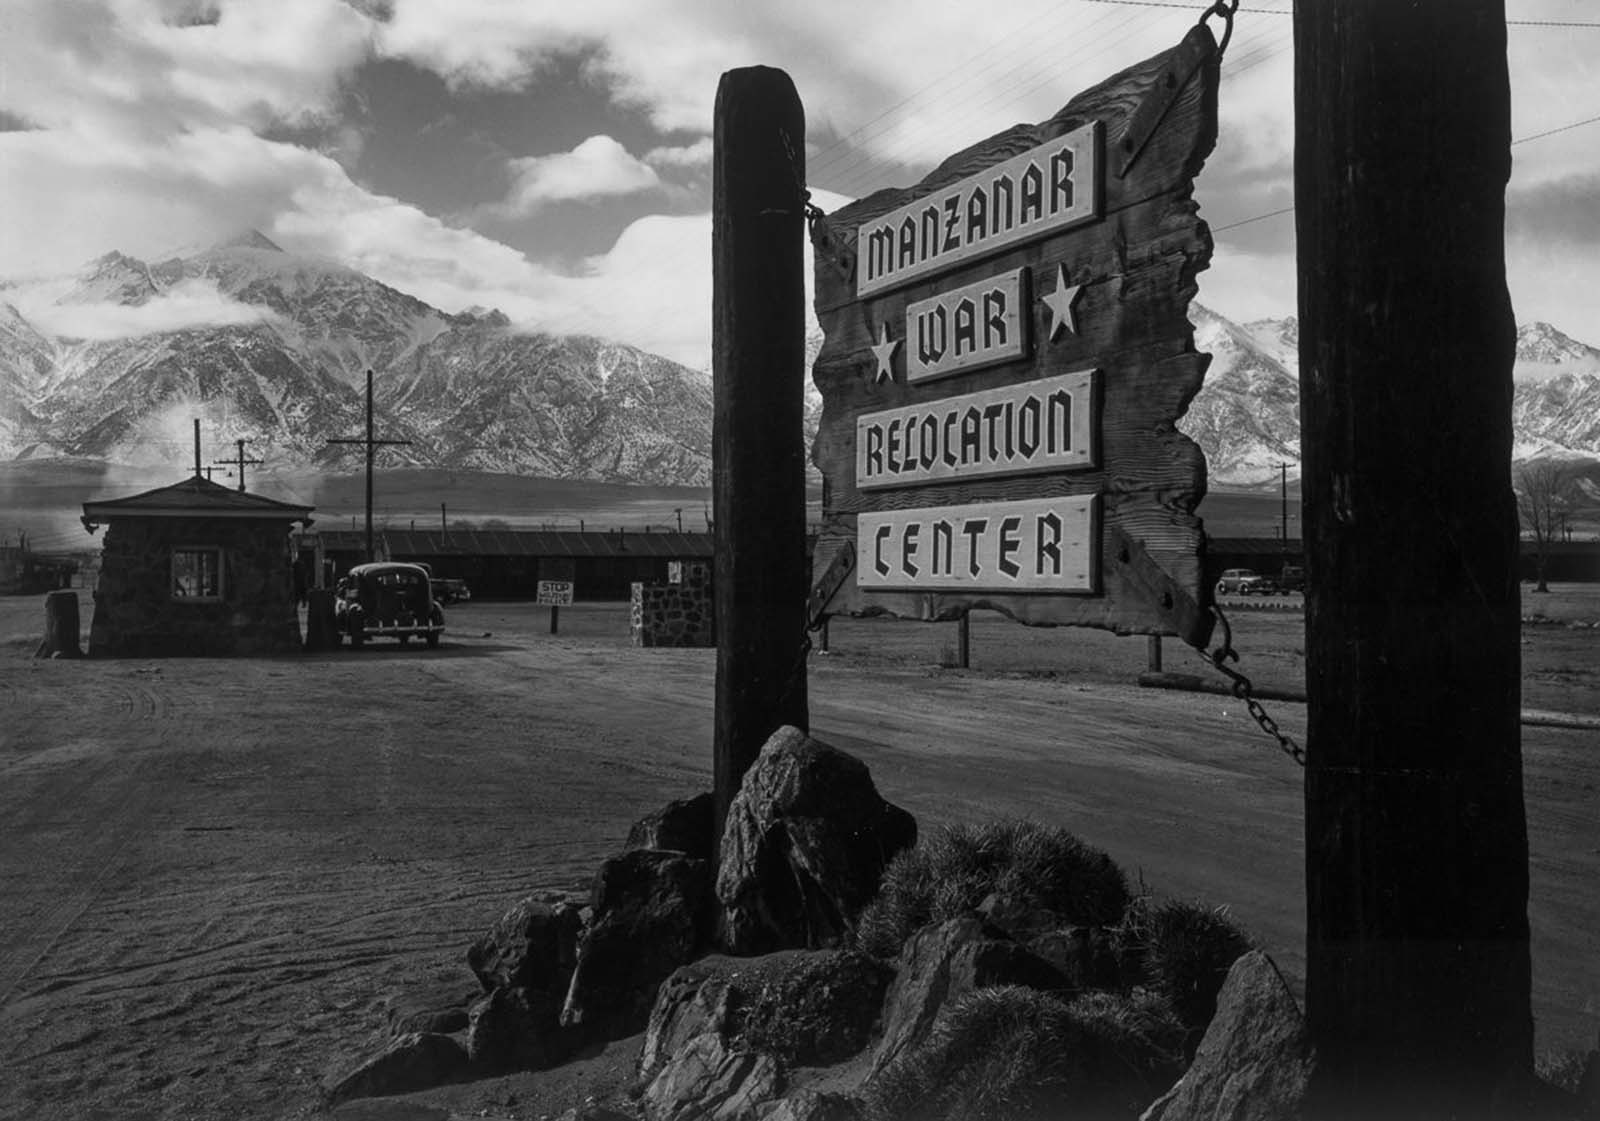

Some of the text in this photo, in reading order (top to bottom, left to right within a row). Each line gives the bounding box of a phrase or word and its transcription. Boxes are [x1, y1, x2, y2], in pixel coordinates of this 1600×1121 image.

[868, 147, 1075, 281] MANZANAR
[918, 288, 1007, 366] WAR
[867, 389, 1072, 477] RELOCATION
[875, 512, 1062, 579] CENTER
[543, 582, 569, 592] STOP
